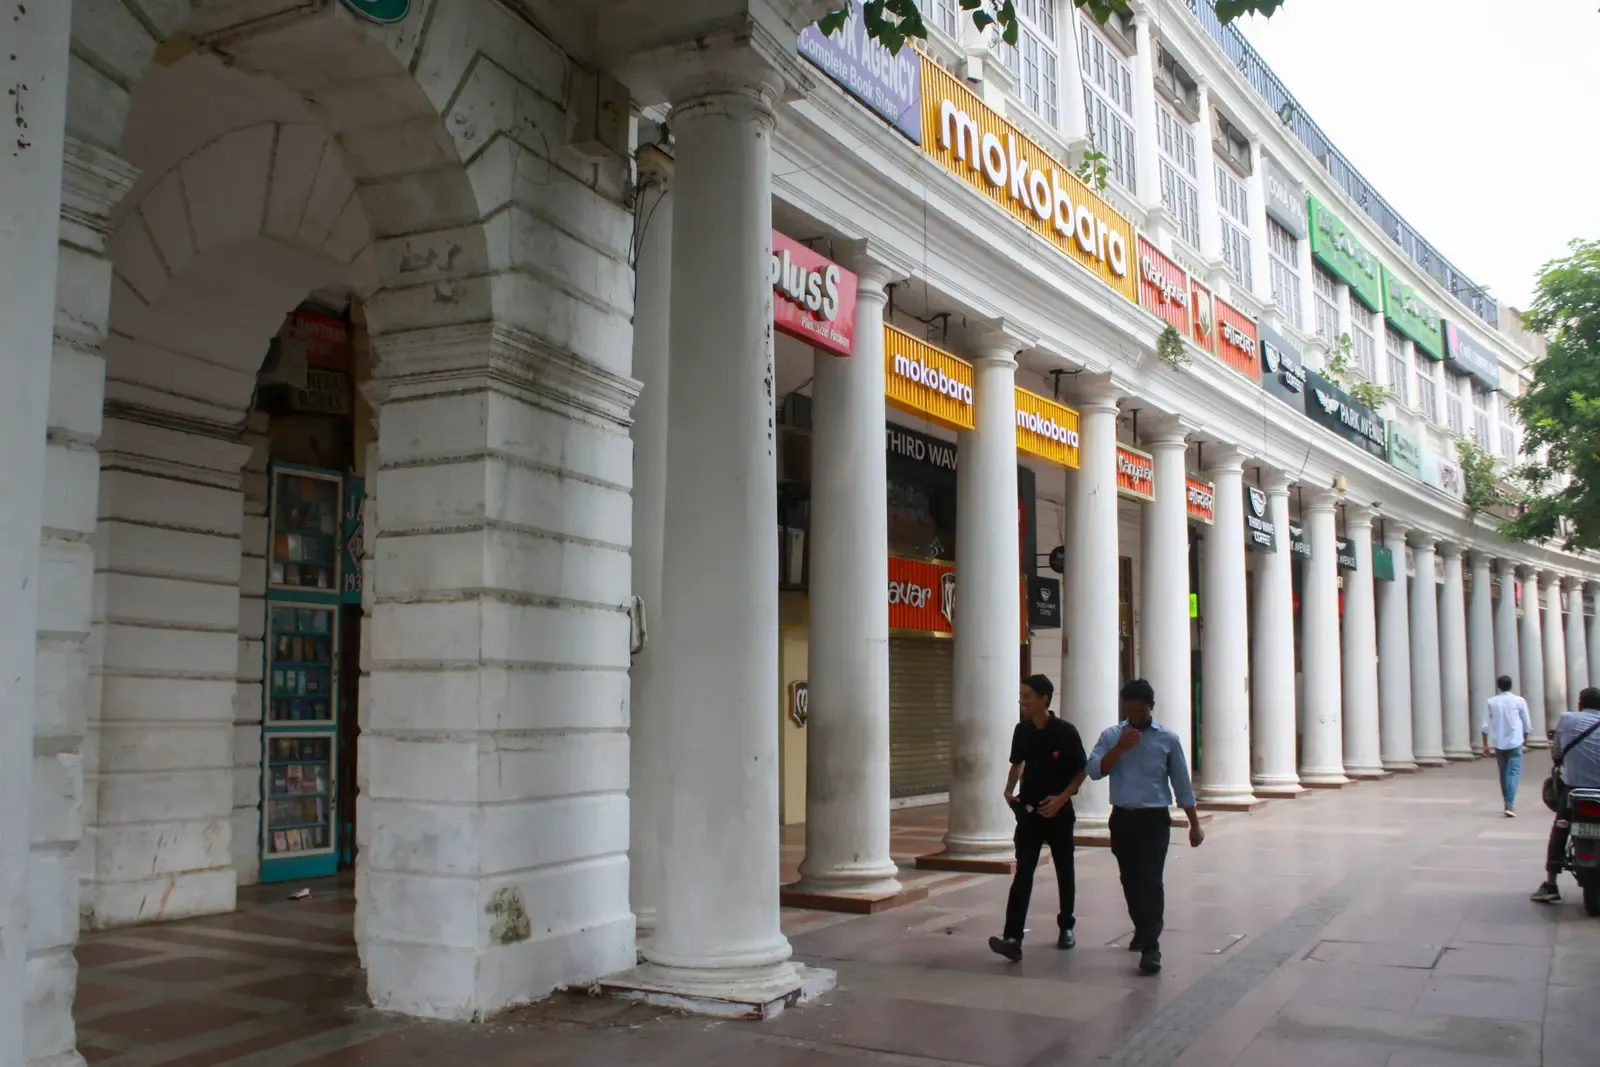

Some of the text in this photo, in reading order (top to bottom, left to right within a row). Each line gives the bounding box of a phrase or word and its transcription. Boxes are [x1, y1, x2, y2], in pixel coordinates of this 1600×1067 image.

[801, 28, 898, 121] Complete Book Store
[861, 27, 916, 105] AGENCY
[941, 98, 1126, 278] mokobara
[895, 353, 973, 405] mokobara
[886, 429, 925, 461] THIRD
[1017, 410, 1079, 448] mokobara
[1340, 402, 1384, 446] PARK AVENUE
